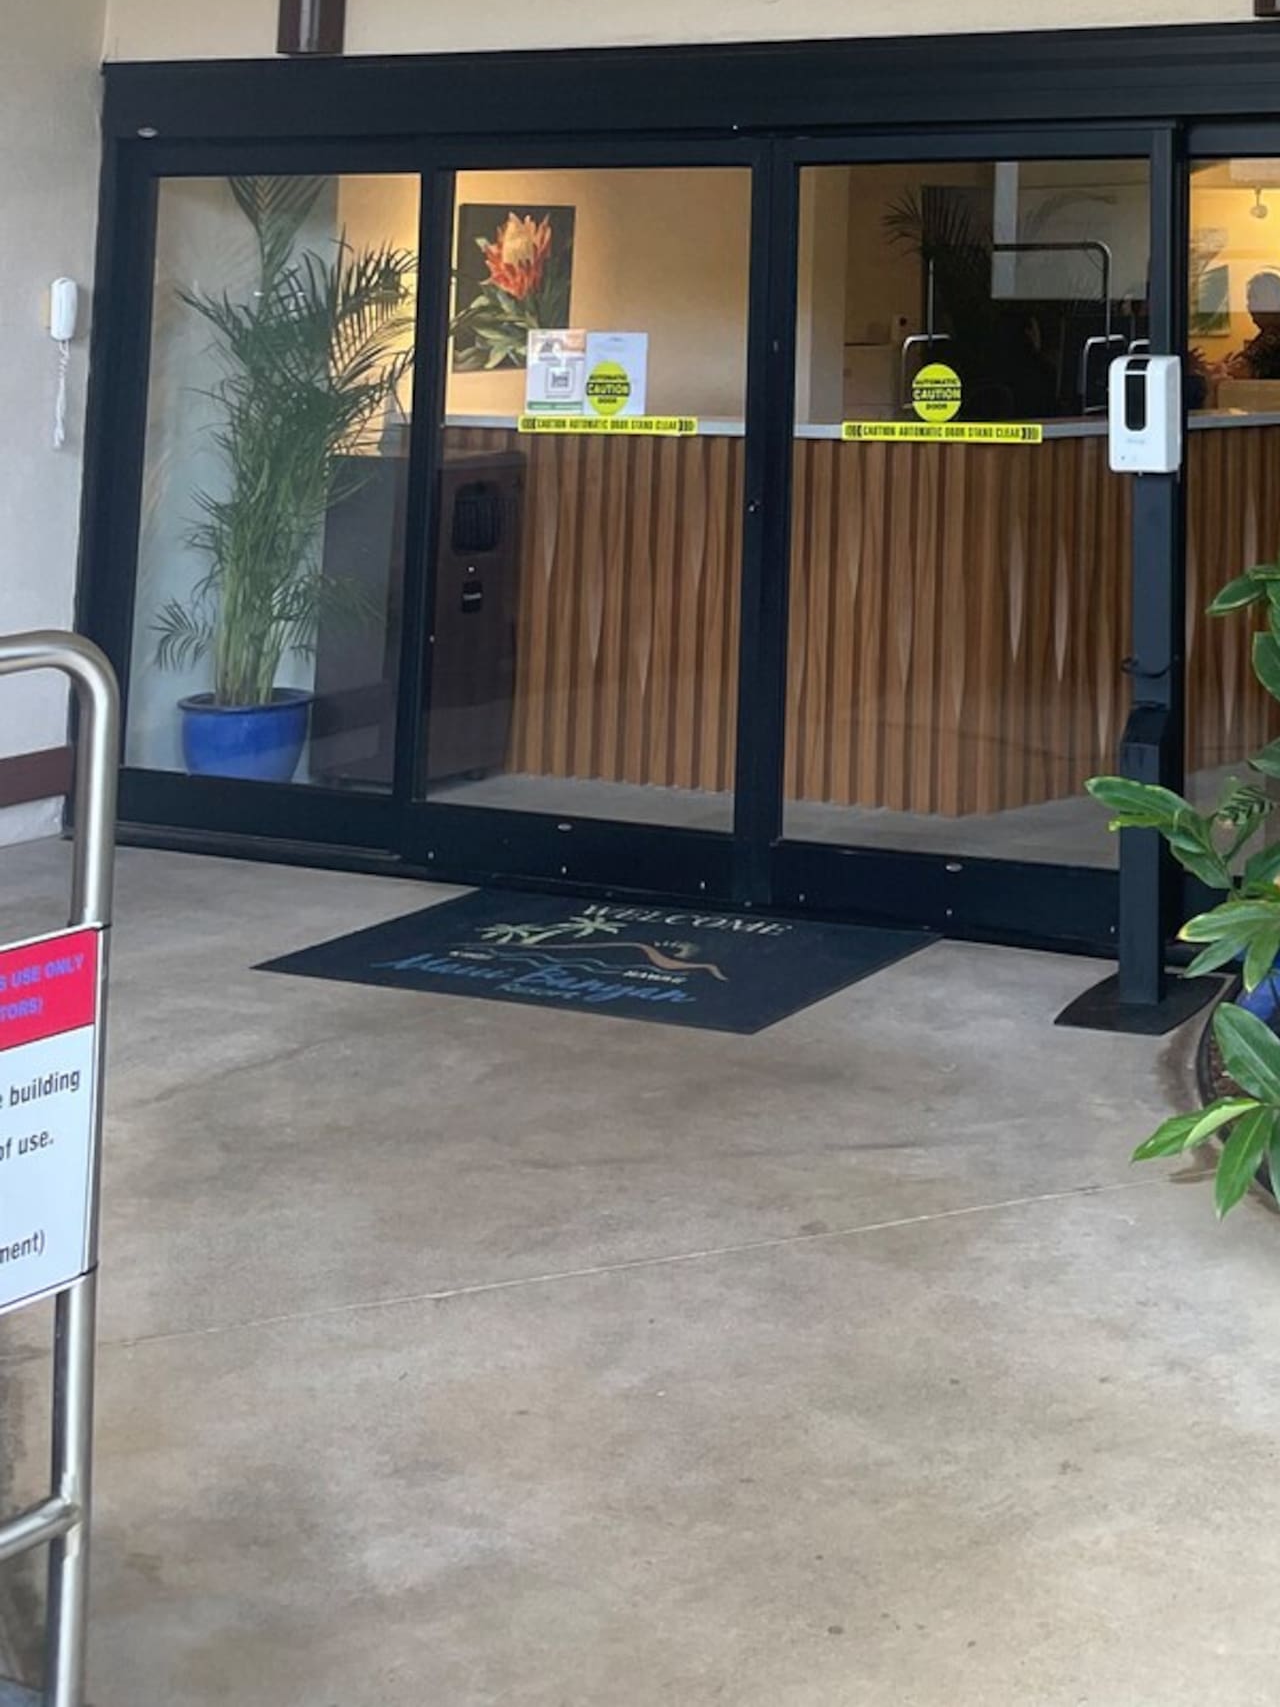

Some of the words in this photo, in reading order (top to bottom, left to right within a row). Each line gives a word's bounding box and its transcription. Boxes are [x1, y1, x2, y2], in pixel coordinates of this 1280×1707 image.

[588, 383, 630, 396] CAUTION
[913, 388, 961, 400] CAUTION
[537, 418, 566, 430] CAUTION
[569, 419, 609, 430] AUTOMATIC
[863, 425, 896, 436] CAUTION
[899, 425, 943, 437] AUTOMATIC
[945, 426, 965, 437] DOOR
[996, 427, 1021, 438] CLEAR
[584, 904, 792, 936] WELCOME
[12, 965, 41, 988] USE
[44, 952, 84, 980] ONLY
[9, 1070, 81, 1107] building
[18, 1130, 54, 1156] use.
